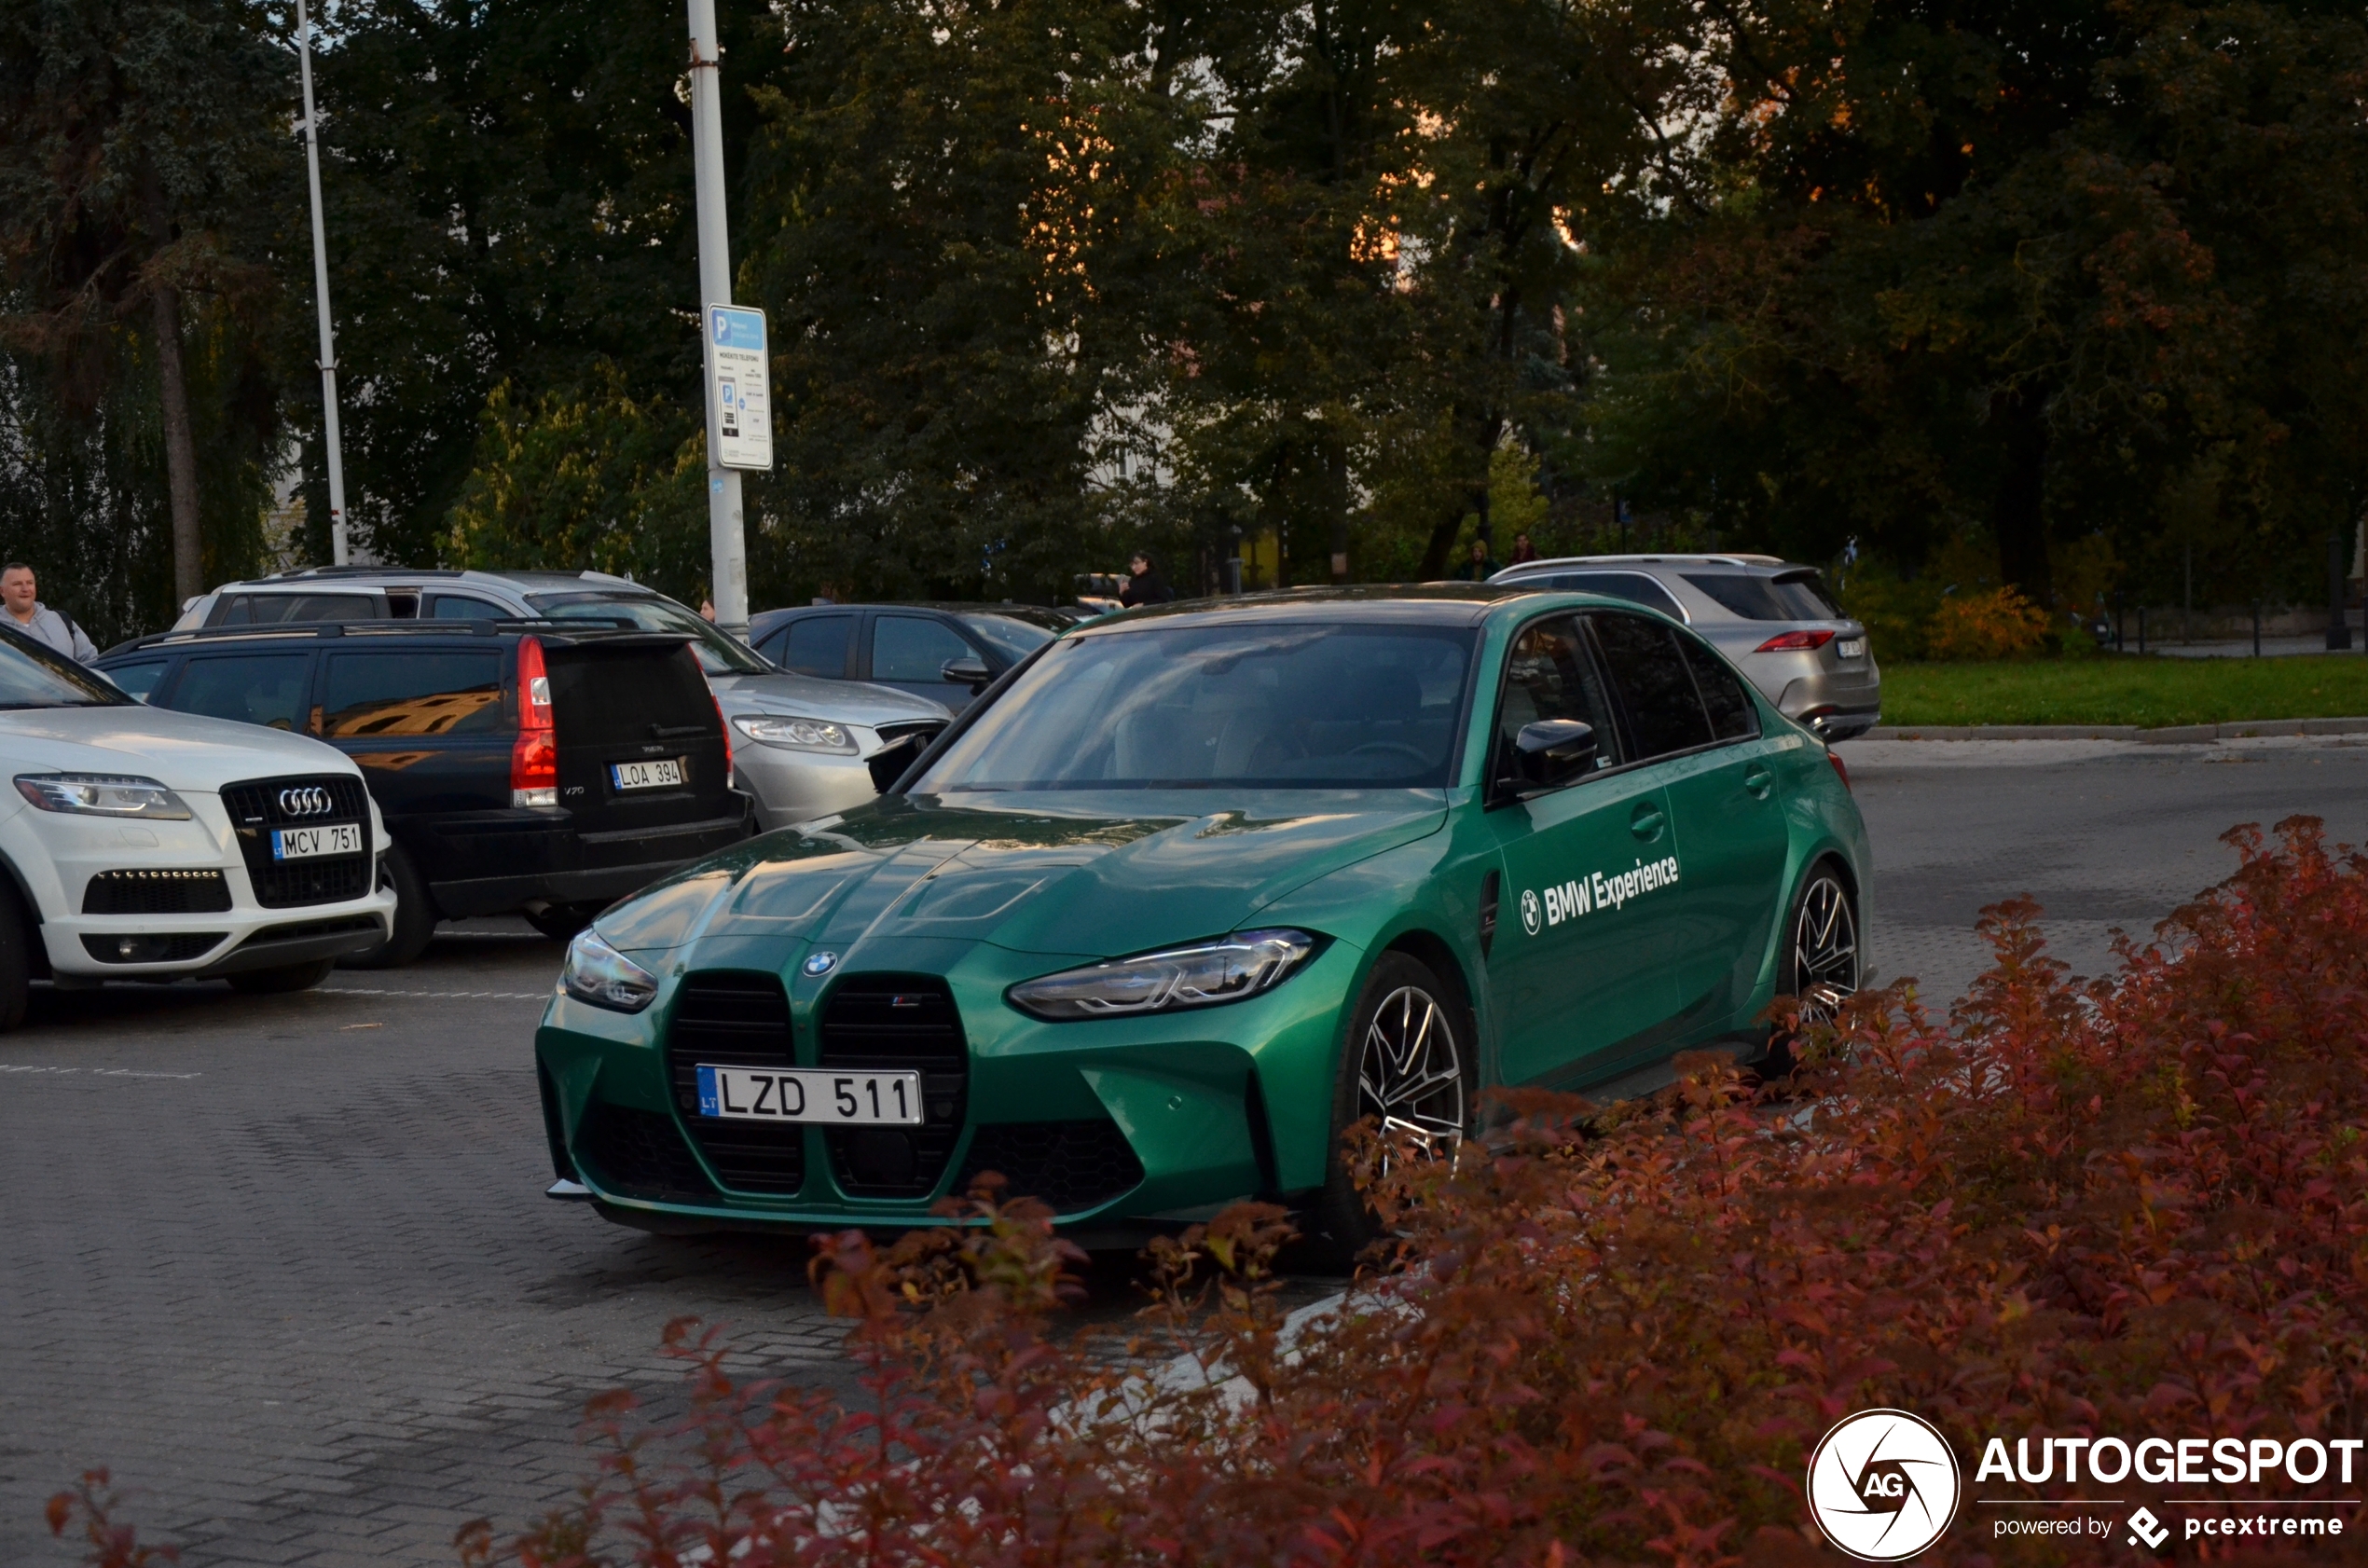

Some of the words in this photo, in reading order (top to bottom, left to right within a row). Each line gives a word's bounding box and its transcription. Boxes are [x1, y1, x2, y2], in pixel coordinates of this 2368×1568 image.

[717, 316, 726, 339] P
[620, 765, 650, 786] LOA
[655, 763, 679, 783] 394
[564, 786, 585, 795] V70
[284, 830, 320, 855] MCV
[331, 827, 357, 850] 751
[1544, 876, 1591, 926] BMW
[1591, 856, 1678, 910] Experience
[701, 1096, 717, 1109] LT
[722, 1073, 805, 1116] LZD
[833, 1078, 907, 1119] 511
